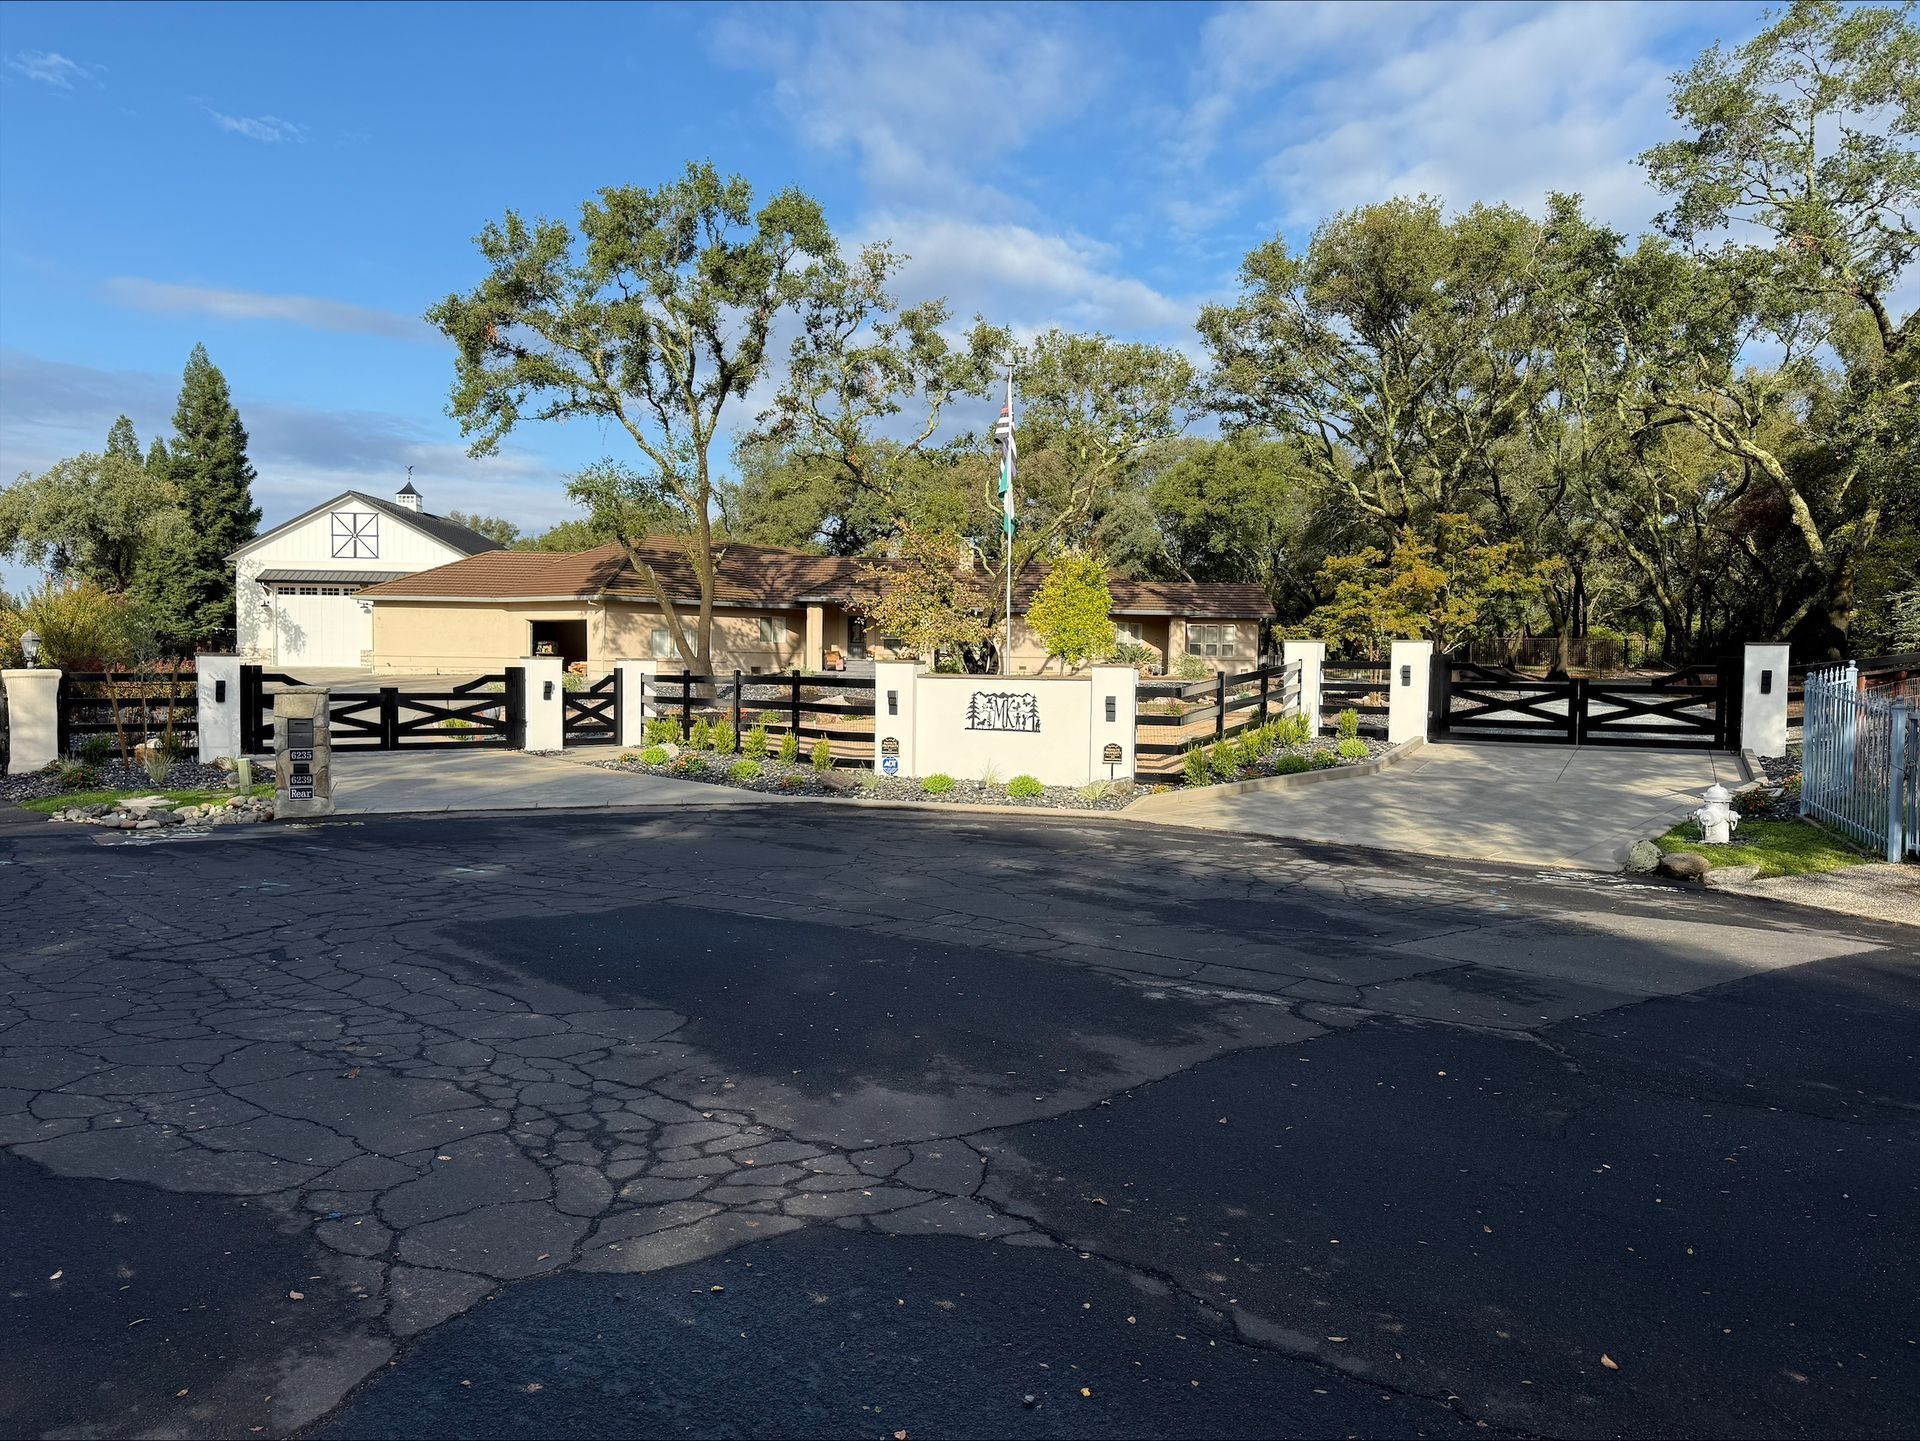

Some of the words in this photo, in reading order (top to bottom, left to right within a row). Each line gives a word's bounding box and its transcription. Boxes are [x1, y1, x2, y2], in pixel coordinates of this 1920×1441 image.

[291, 751, 312, 760] 6235
[291, 776, 312, 784] 6239
[291, 790, 312, 798] Rear
